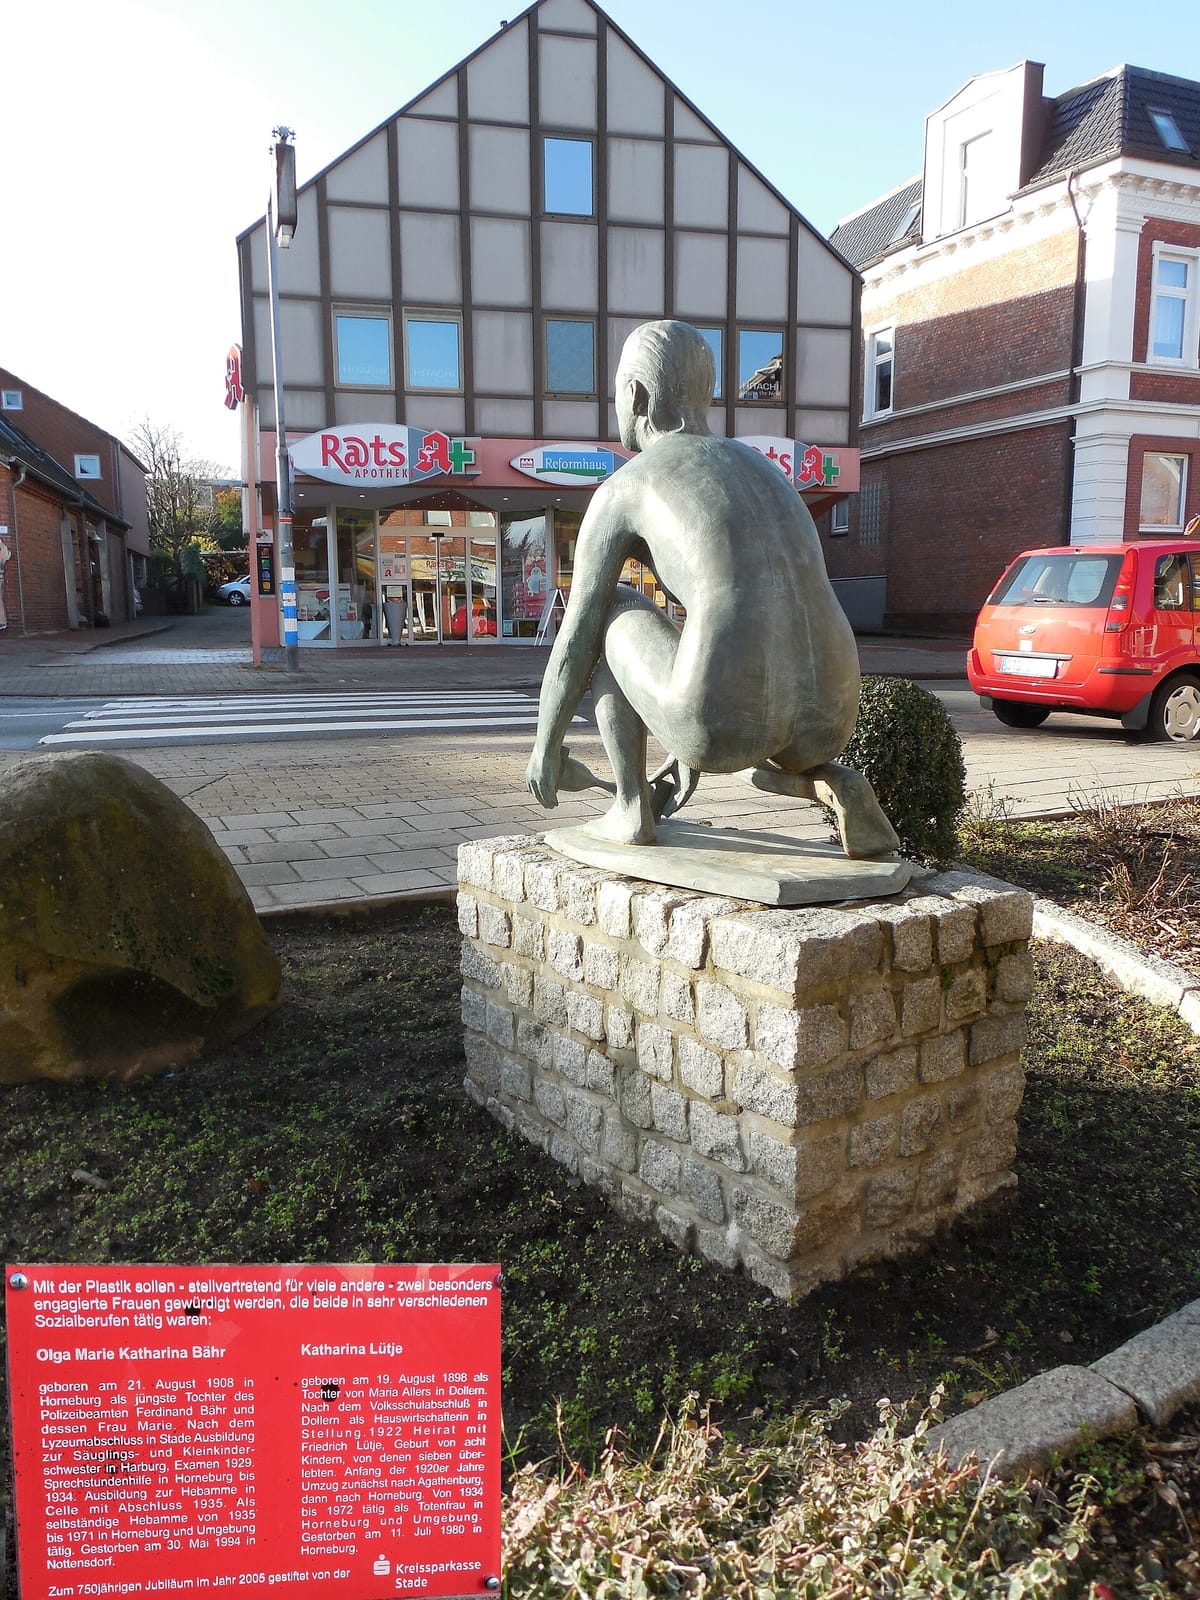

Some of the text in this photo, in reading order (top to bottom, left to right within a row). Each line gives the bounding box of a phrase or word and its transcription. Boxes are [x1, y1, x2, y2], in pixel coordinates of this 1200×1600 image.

[545, 457, 607, 471] Reformhaus
[354, 468, 415, 479] APOTHEKE
[33, 1277, 492, 1293] Mit der Plastik sollen stellvertretend für viele andere zwei besonders
[34, 1293, 487, 1313] engagierte Frauen gewürdigt werden, die beide sehr verschiedenen
[35, 1314, 211, 1329] Sozialberufen tätig waren:
[36, 1346, 226, 1364] Olga Marie Katharina Bähr
[301, 1342, 402, 1357] Katharina Lütje
[38, 1377, 234, 1394] geboren 21. August 1908
[301, 1371, 467, 1388] geboren August 1898
[39, 1390, 254, 1408] Horneburg jüngste Tochter des
[301, 1384, 487, 1399] Tochter von Maria Allers Dollern.
[40, 1404, 226, 1420] Polizeibeamten Ferdinand Bähr
[301, 1397, 470, 1412] Nach dem Volksschulabschluß
[41, 1417, 254, 1434] dessen Frau Marie. Nach dem
[301, 1410, 468, 1426] Dollern Hauswirtschafterin
[369, 1425, 402, 1437] 1922
[413, 1423, 455, 1436] Heirat
[42, 1431, 254, 1451] Lyzeumabschluss Stade Ausbildung
[301, 1435, 486, 1453] Friedrich Lütje, Geburt von acht
[42, 1444, 254, 1463] zur Säuglings- Kleinkinder-
[301, 1448, 485, 1466] Kindern, von denen sieben über-
[43, 1457, 254, 1476] schwester Harburg. Examen 1929.
[301, 1461, 484, 1478] lebten. Anfang der 1920er Jahre
[44, 1470, 255, 1492] Sprechstundenhilfe Horneburg bis
[301, 1474, 483, 1493] Umzug zunächst nach Agathenburg,
[45, 1485, 237, 1502] 1934. Ausbildung zur Hebamme
[301, 1485, 483, 1504] dann nach Horneburg. Von 1934
[45, 1496, 255, 1516] Celle Abschluss 1935. Als
[301, 1499, 465, 1517] bis 1972 tätig Totenfrau
[46, 1509, 256, 1529] selbständige Hebamme von 1935
[301, 1511, 482, 1529] Horneburg und Umgebung.
[46, 1523, 255, 1543] bis 1971 Horneburg und Umgebung
[301, 1522, 464, 1542] Gestorben Juli 1980
[47, 1535, 240, 1558] tätig. Gestorben Mai 1994
[301, 1543, 358, 1556] Horneburg.
[47, 1556, 114, 1569] Nottensdorf.
[396, 1560, 481, 1576] Kreissparkasse
[48, 1567, 350, 1597] Zum 750jährigen Jubiläum Jahr 2005 gestiftet von der
[395, 1575, 427, 1588] Stade
